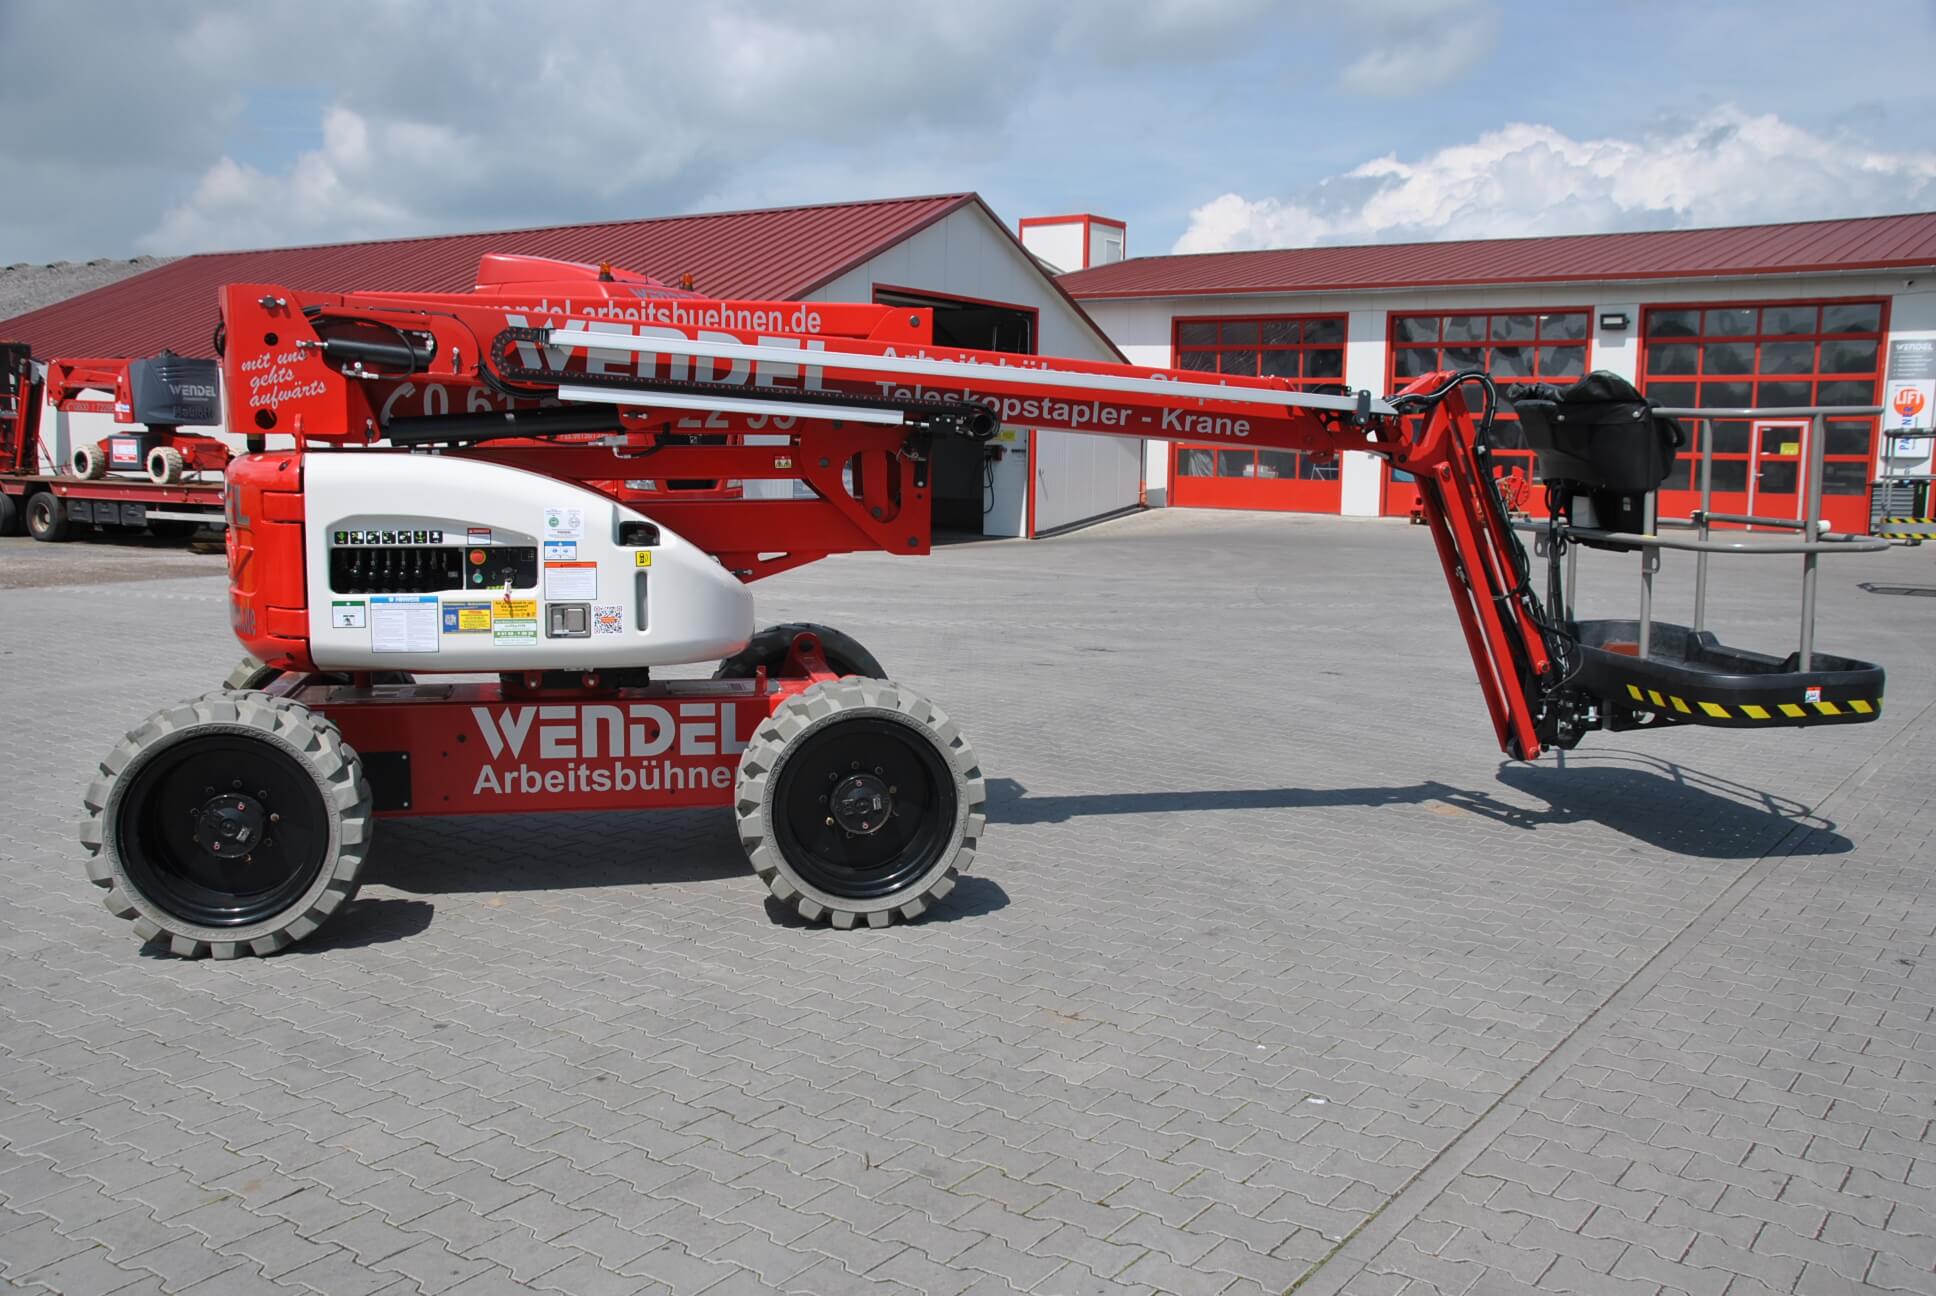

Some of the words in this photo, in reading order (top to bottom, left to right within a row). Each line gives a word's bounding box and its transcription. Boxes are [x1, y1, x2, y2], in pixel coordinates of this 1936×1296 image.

[241, 352, 271, 371] mit
[277, 349, 306, 365] uns
[505, 313, 843, 395] WENDEL
[168, 383, 217, 397] WENDEL
[249, 365, 295, 395] gehts
[249, 380, 327, 410] aufwärts
[875, 381, 1132, 428] Teleskopstapler
[1161, 407, 1251, 437] Krane
[1895, 389, 1921, 405] LIFT
[471, 702, 751, 760] WENDEL
[472, 760, 738, 796] Arbeitsbühne
